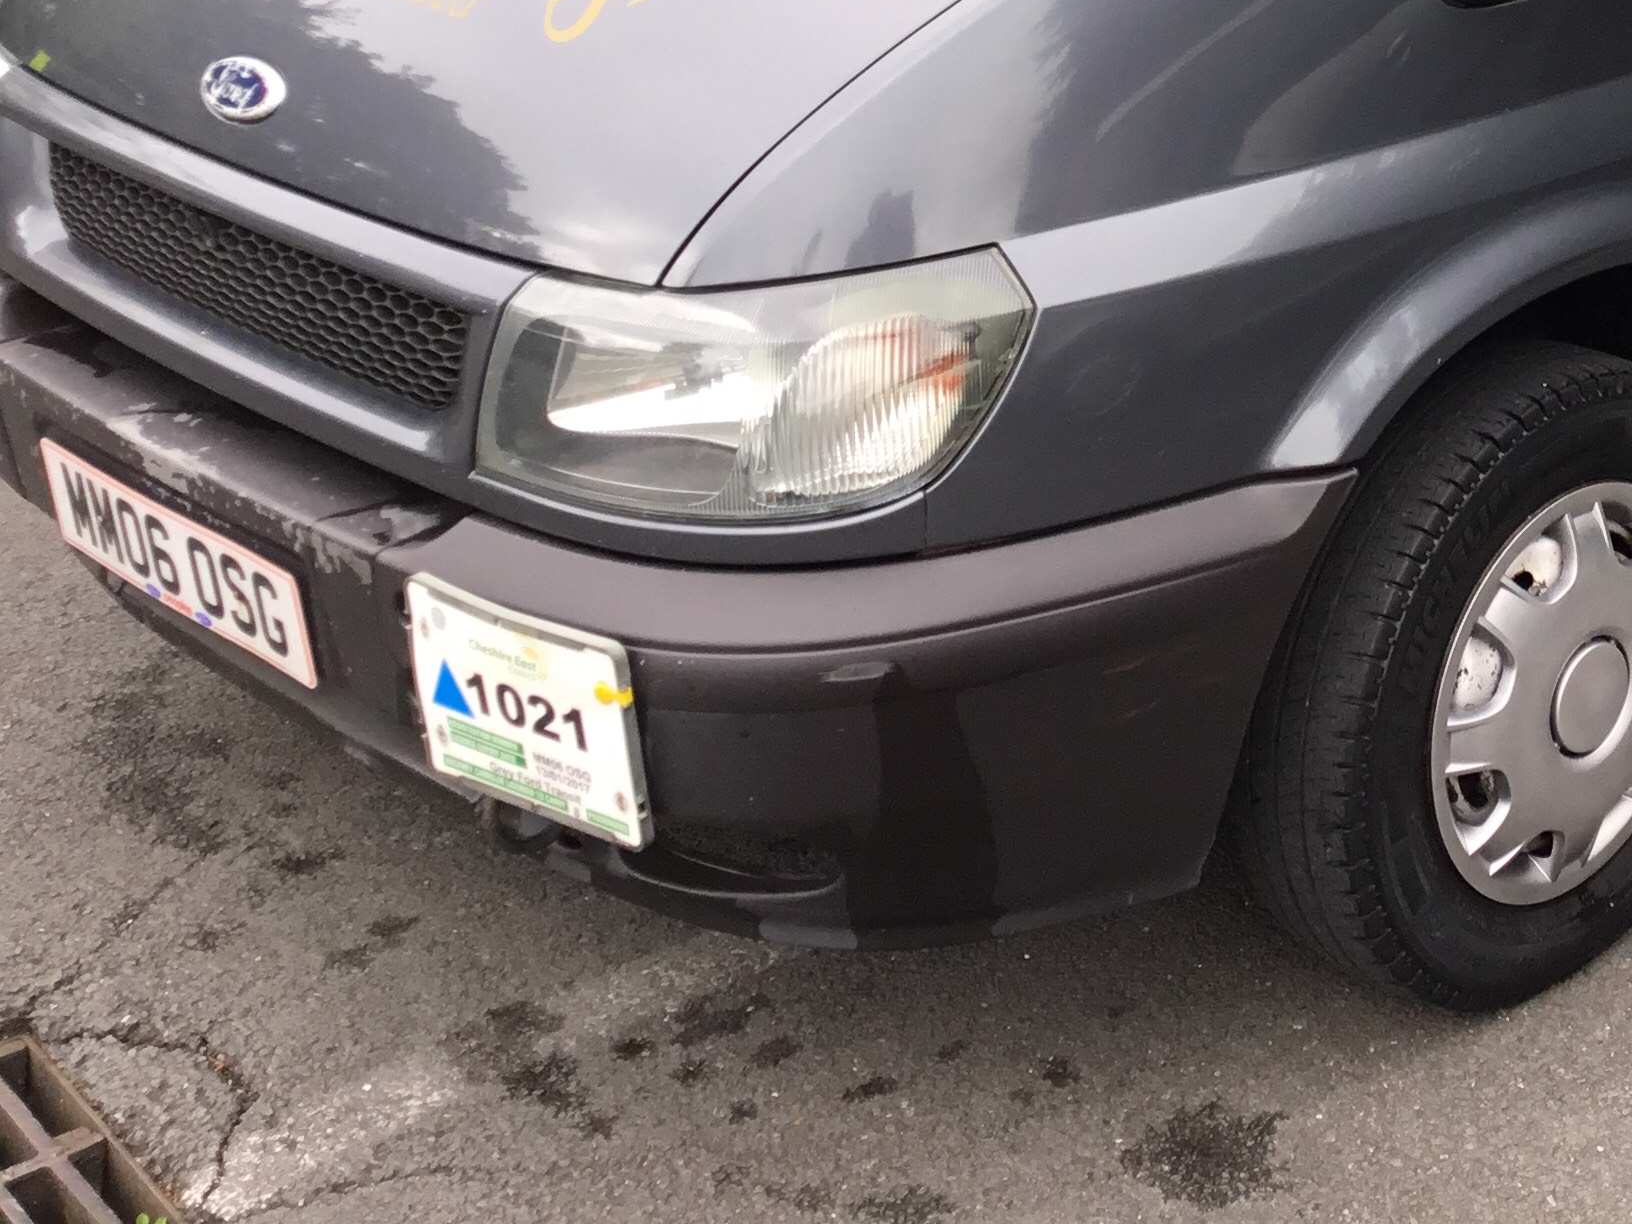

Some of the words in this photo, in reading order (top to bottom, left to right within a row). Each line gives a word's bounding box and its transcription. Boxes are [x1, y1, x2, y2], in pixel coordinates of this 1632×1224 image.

[60, 462, 181, 596] MM06
[186, 536, 289, 658] OSG
[468, 638, 512, 664] Cheshire
[514, 654, 537, 672] East
[466, 672, 588, 752] 1021
[517, 771, 542, 790] Ford
[543, 781, 582, 806] Transit
